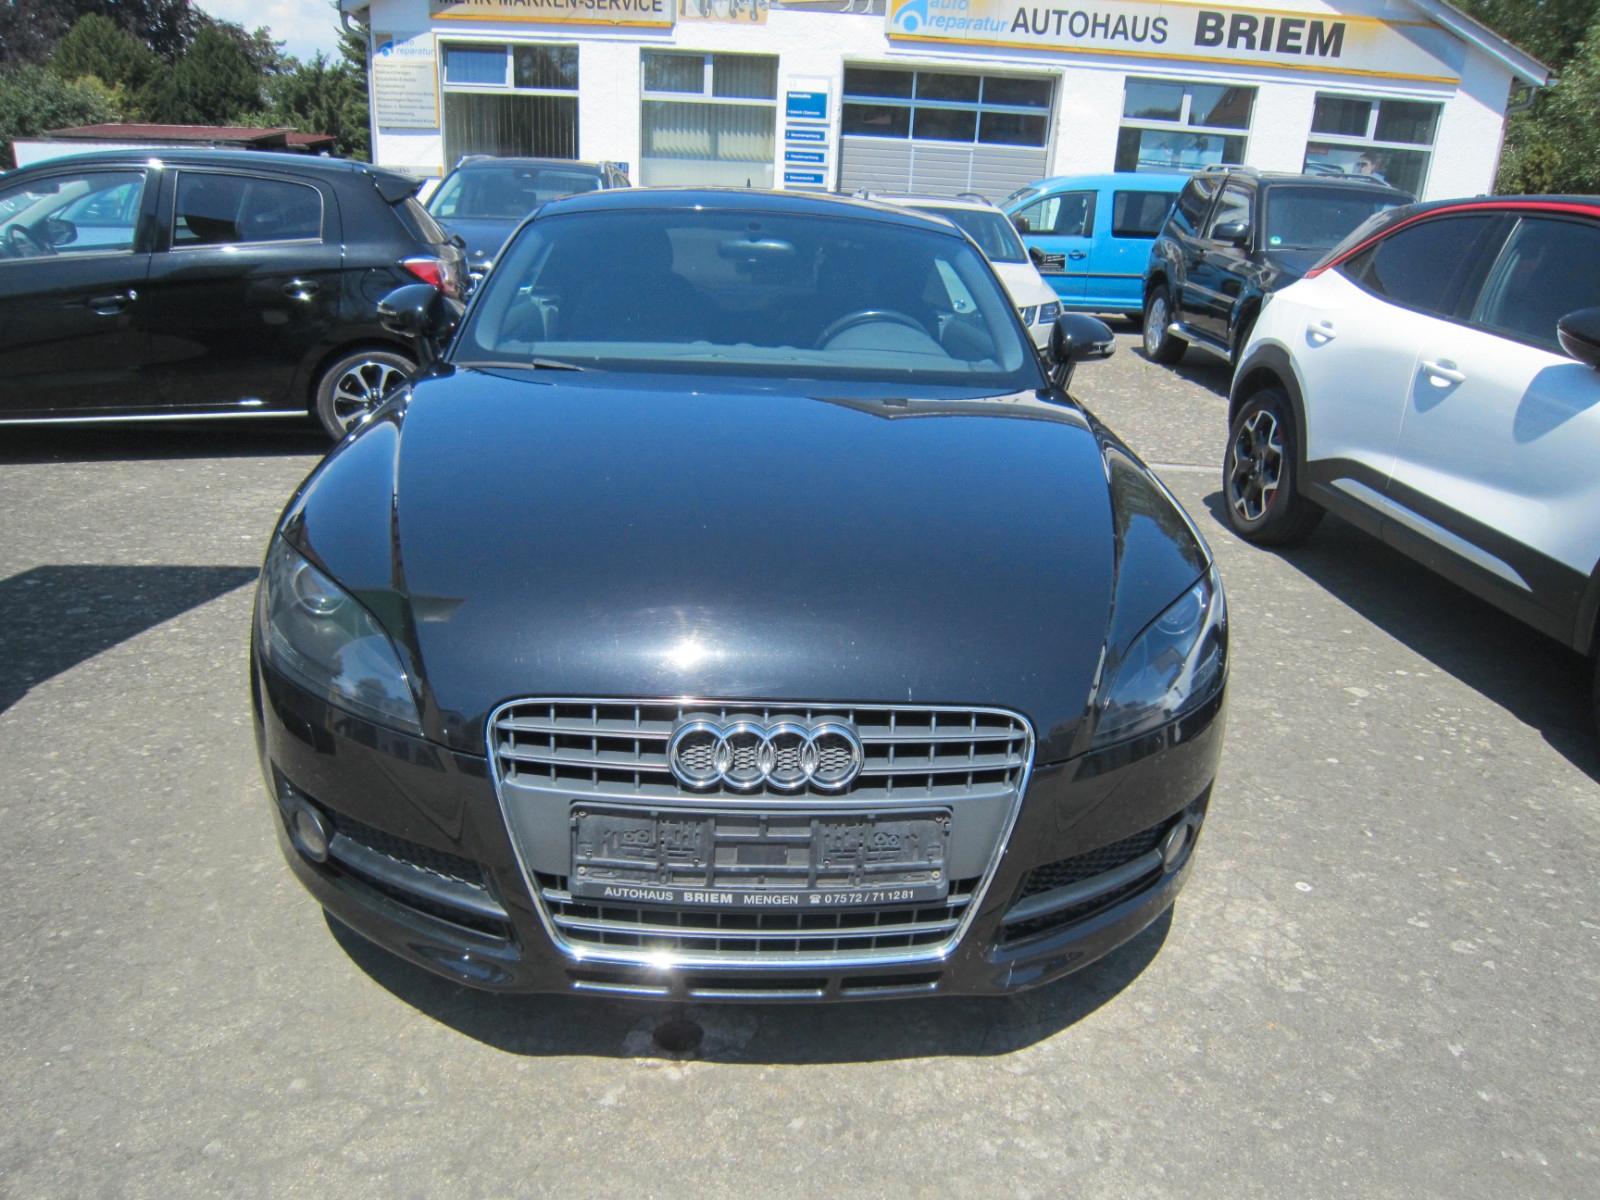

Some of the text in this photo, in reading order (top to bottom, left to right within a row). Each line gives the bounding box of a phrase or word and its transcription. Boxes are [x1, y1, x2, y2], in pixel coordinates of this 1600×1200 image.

[928, 15, 1008, 33] reparatur
[1010, 7, 1346, 58] AUTOHAUS BRIEM
[604, 886, 674, 901] AUTOHAUS
[683, 891, 733, 904] BRIEM
[743, 895, 799, 905] MENGEN
